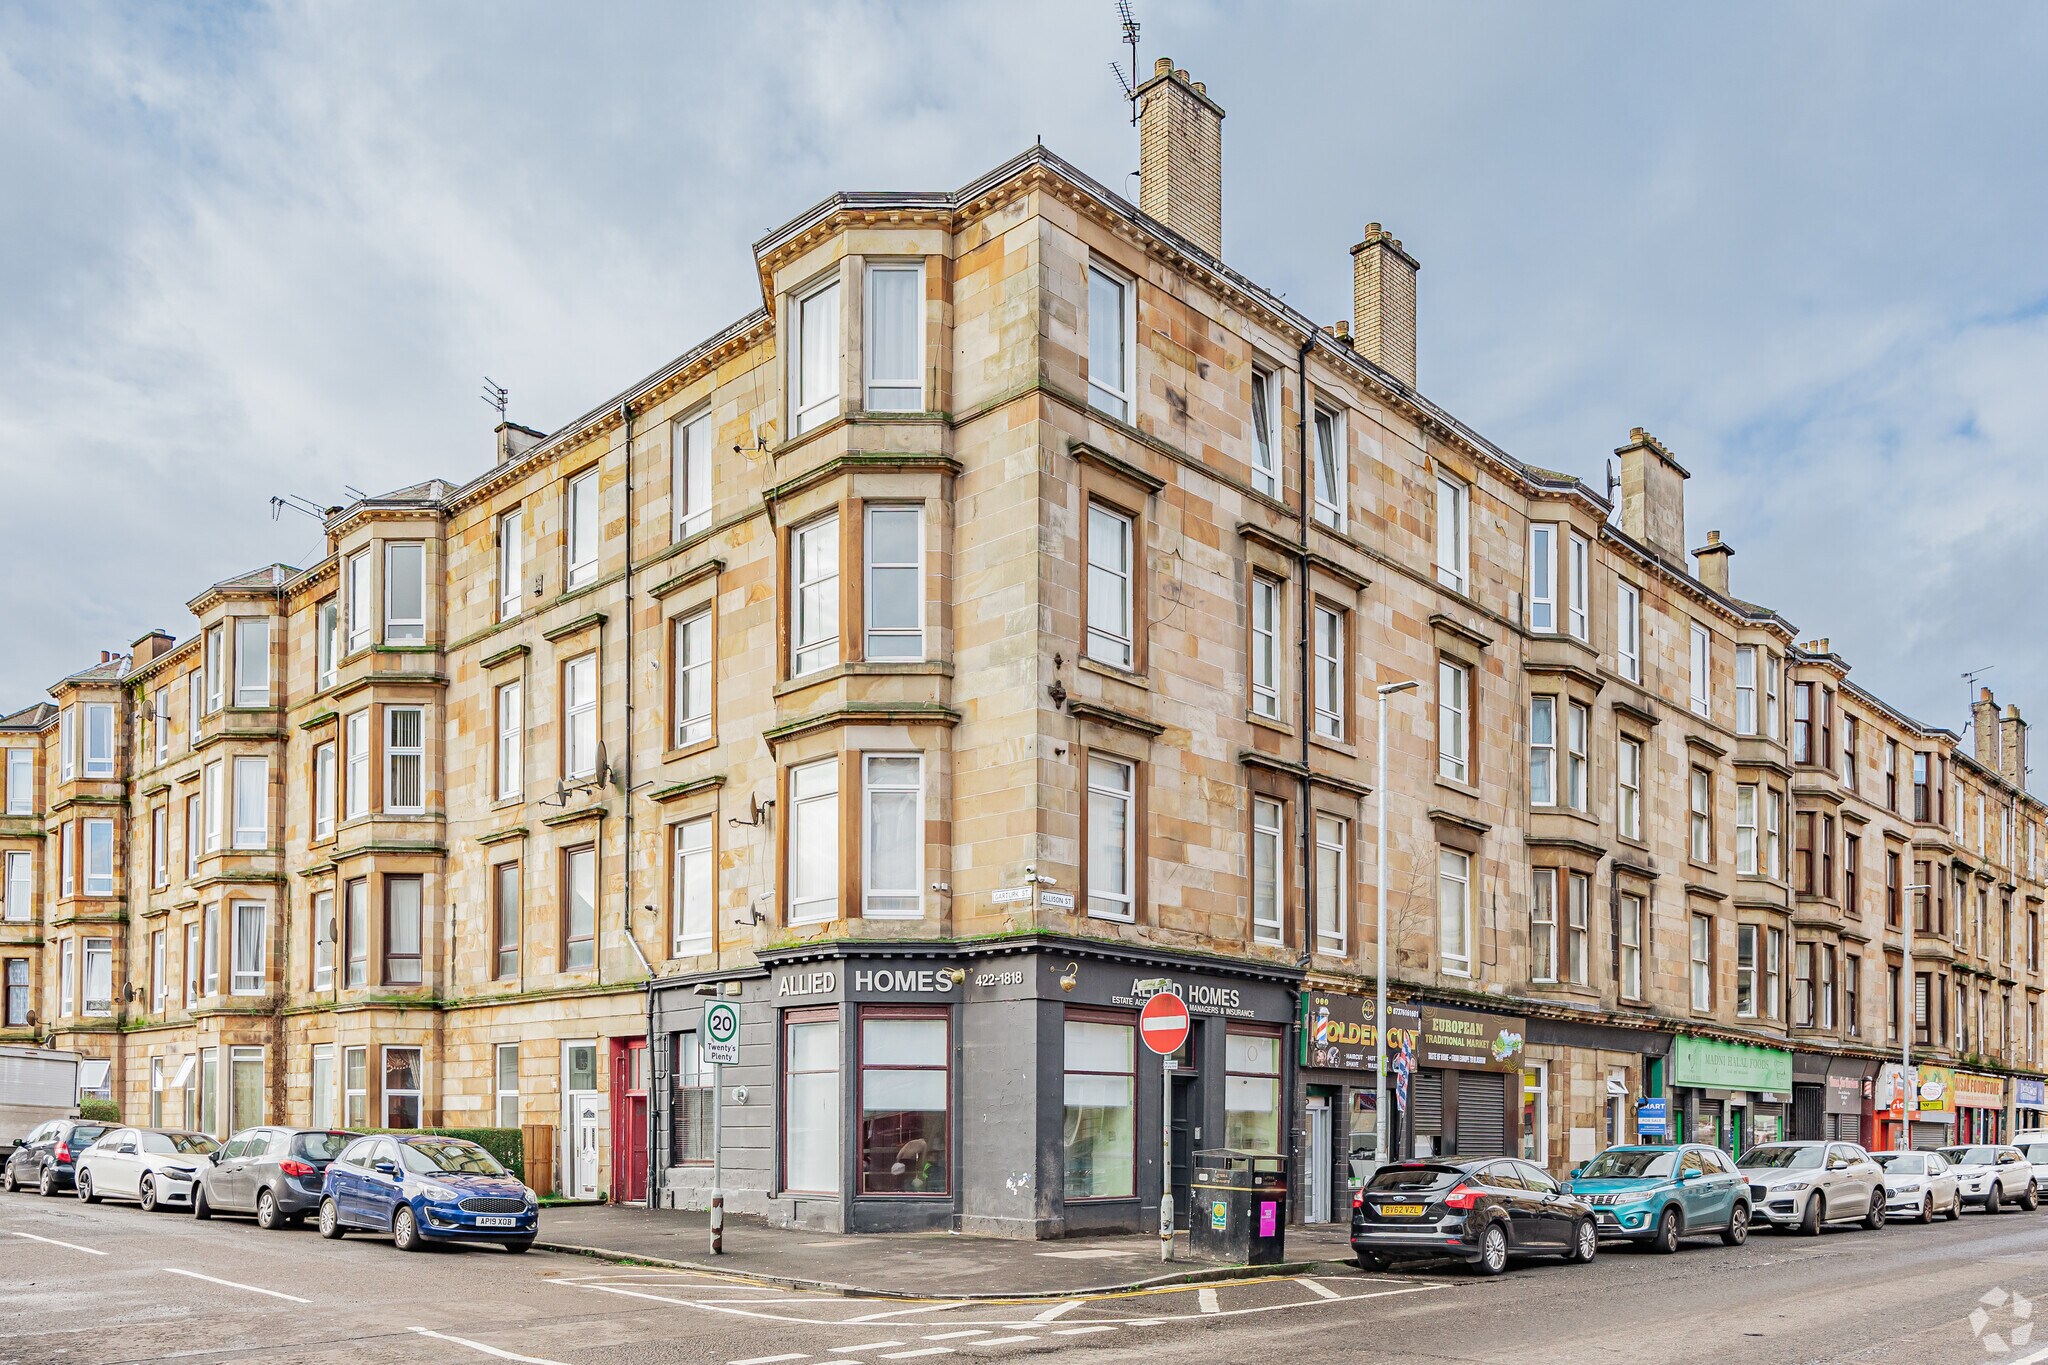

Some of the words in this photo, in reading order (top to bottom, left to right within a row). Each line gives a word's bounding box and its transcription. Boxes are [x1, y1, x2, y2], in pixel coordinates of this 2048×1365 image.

[1043, 895, 1064, 904] ALLISON
[779, 971, 836, 997] ALLIED
[855, 970, 953, 992] HOMES
[975, 971, 1023, 987] 422-1818
[1188, 984, 1240, 1008] HOMES
[1112, 995, 1133, 1005] ESTATE
[1189, 1004, 1219, 1015] MANAGERS
[1220, 1007, 1225, 1015] &
[1226, 1008, 1255, 1018] INSURANCE
[713, 1015, 732, 1031] 20
[1432, 1018, 1484, 1036] EUROPEAN
[1313, 1020, 1378, 1046] OLDEN
[708, 1042, 736, 1052] Twenty's
[1425, 1034, 1465, 1047] TRADITIONAL
[1466, 1038, 1490, 1049] MARKET
[711, 1052, 733, 1061] Plenty
[1345, 1053, 1363, 1061] HAIRCUT
[1705, 1054, 1726, 1066] MADNI
[1727, 1056, 1748, 1068] HALAL
[1749, 1058, 1769, 1070] FOODS
[1971, 1079, 2000, 1095] FOODSTORE
[480, 1217, 497, 1225] AP19
[498, 1218, 512, 1226] XOB
